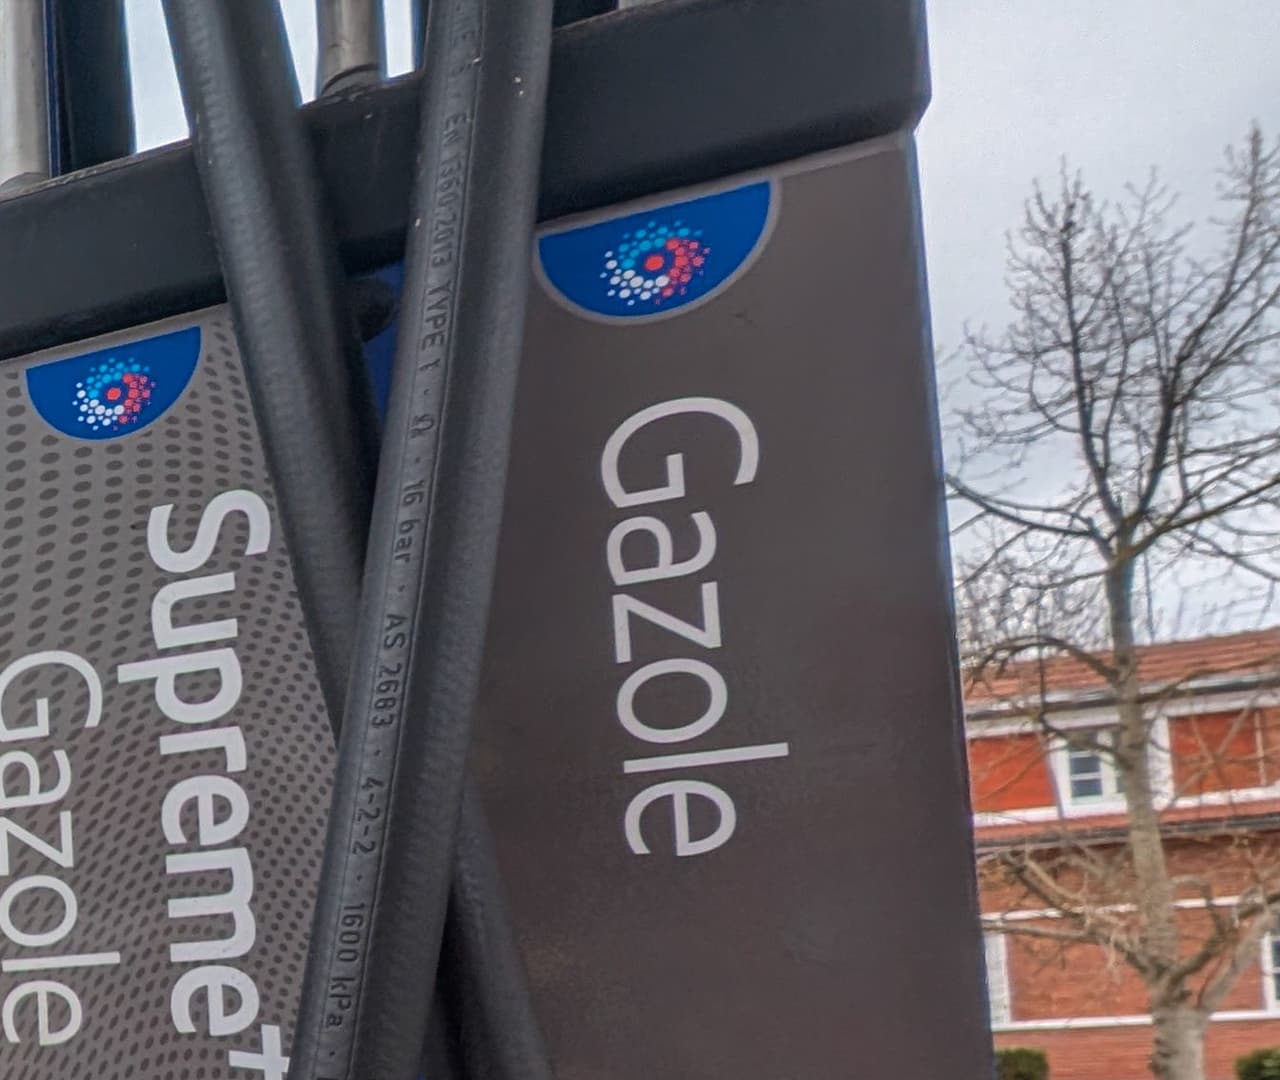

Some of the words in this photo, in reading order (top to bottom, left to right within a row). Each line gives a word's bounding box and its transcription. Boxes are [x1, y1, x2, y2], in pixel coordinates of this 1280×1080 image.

[394, 517, 420, 563] bar
[384, 612, 408, 649] AS
[601, 396, 789, 857] Gazole
[339, 902, 366, 964] 1600
[325, 976, 355, 1029] kPa
